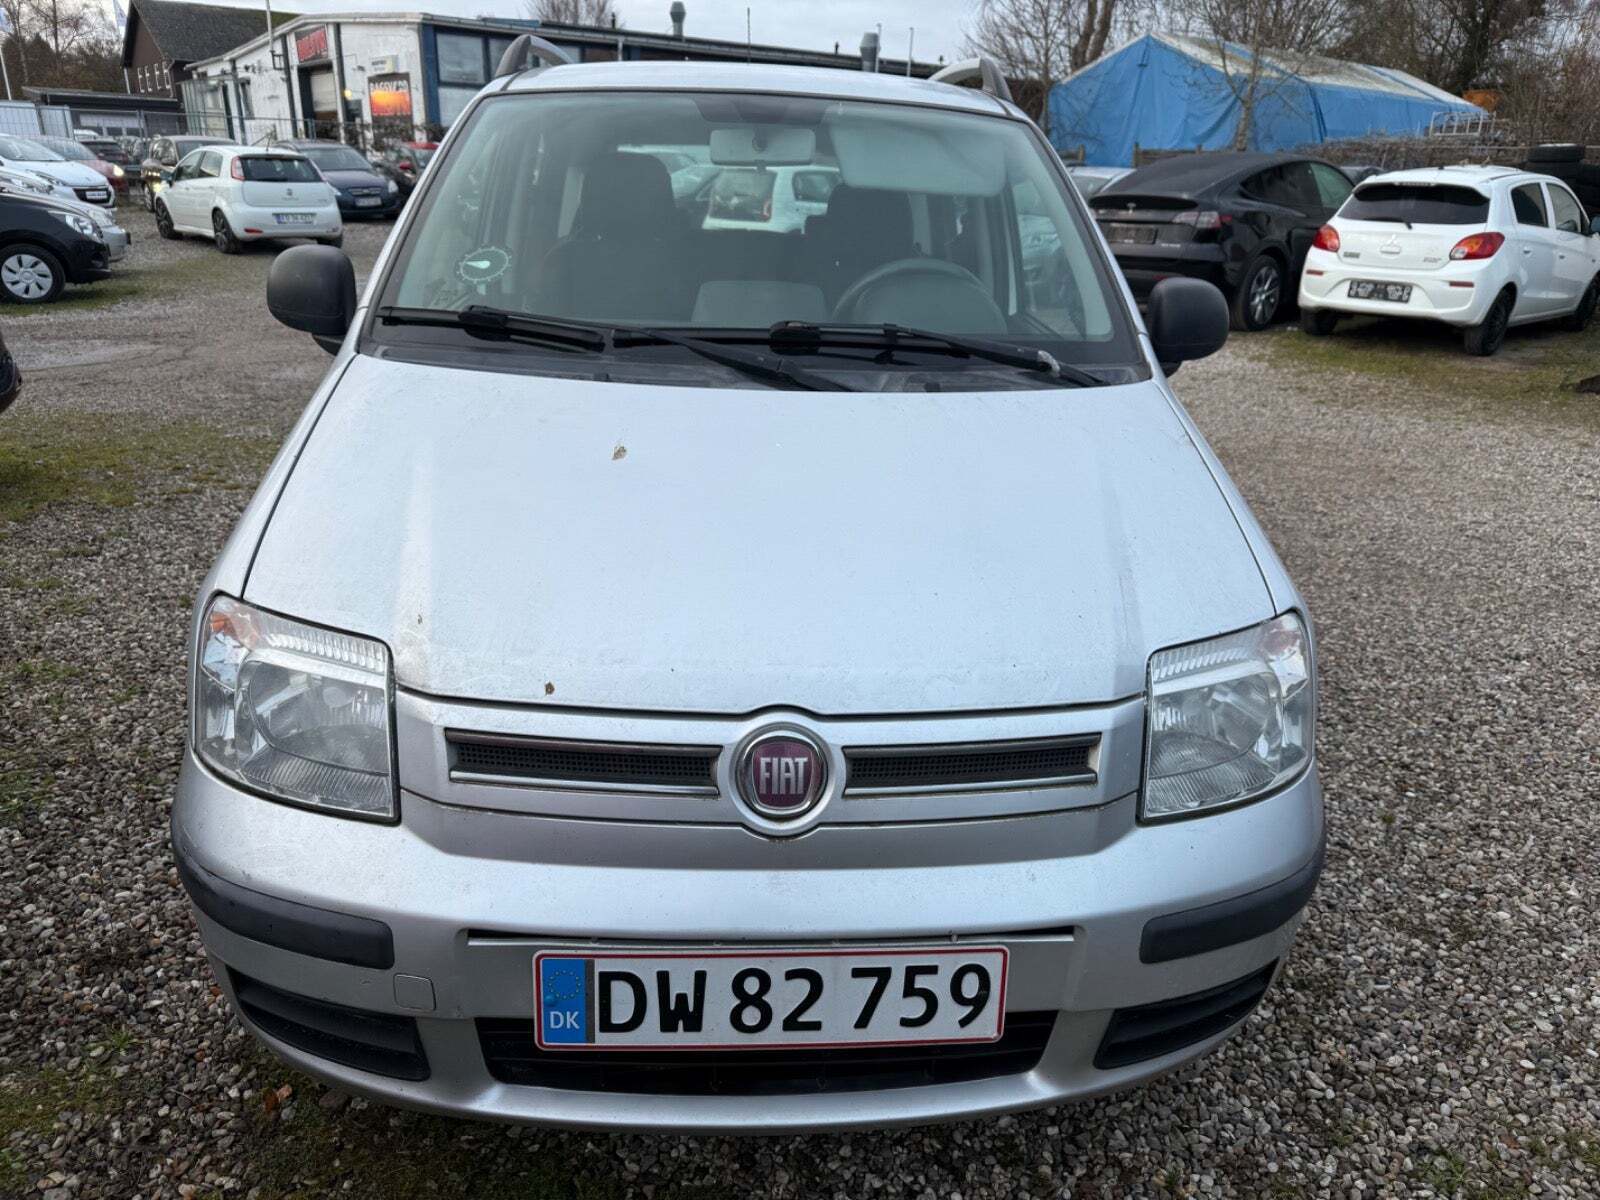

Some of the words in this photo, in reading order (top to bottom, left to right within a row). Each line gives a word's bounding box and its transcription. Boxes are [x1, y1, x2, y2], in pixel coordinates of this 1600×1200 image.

[759, 757, 809, 795] FIAT
[598, 969, 708, 1034] DW
[728, 966, 825, 1034] 82
[850, 963, 993, 1030] 759
[549, 1011, 580, 1030] DK
